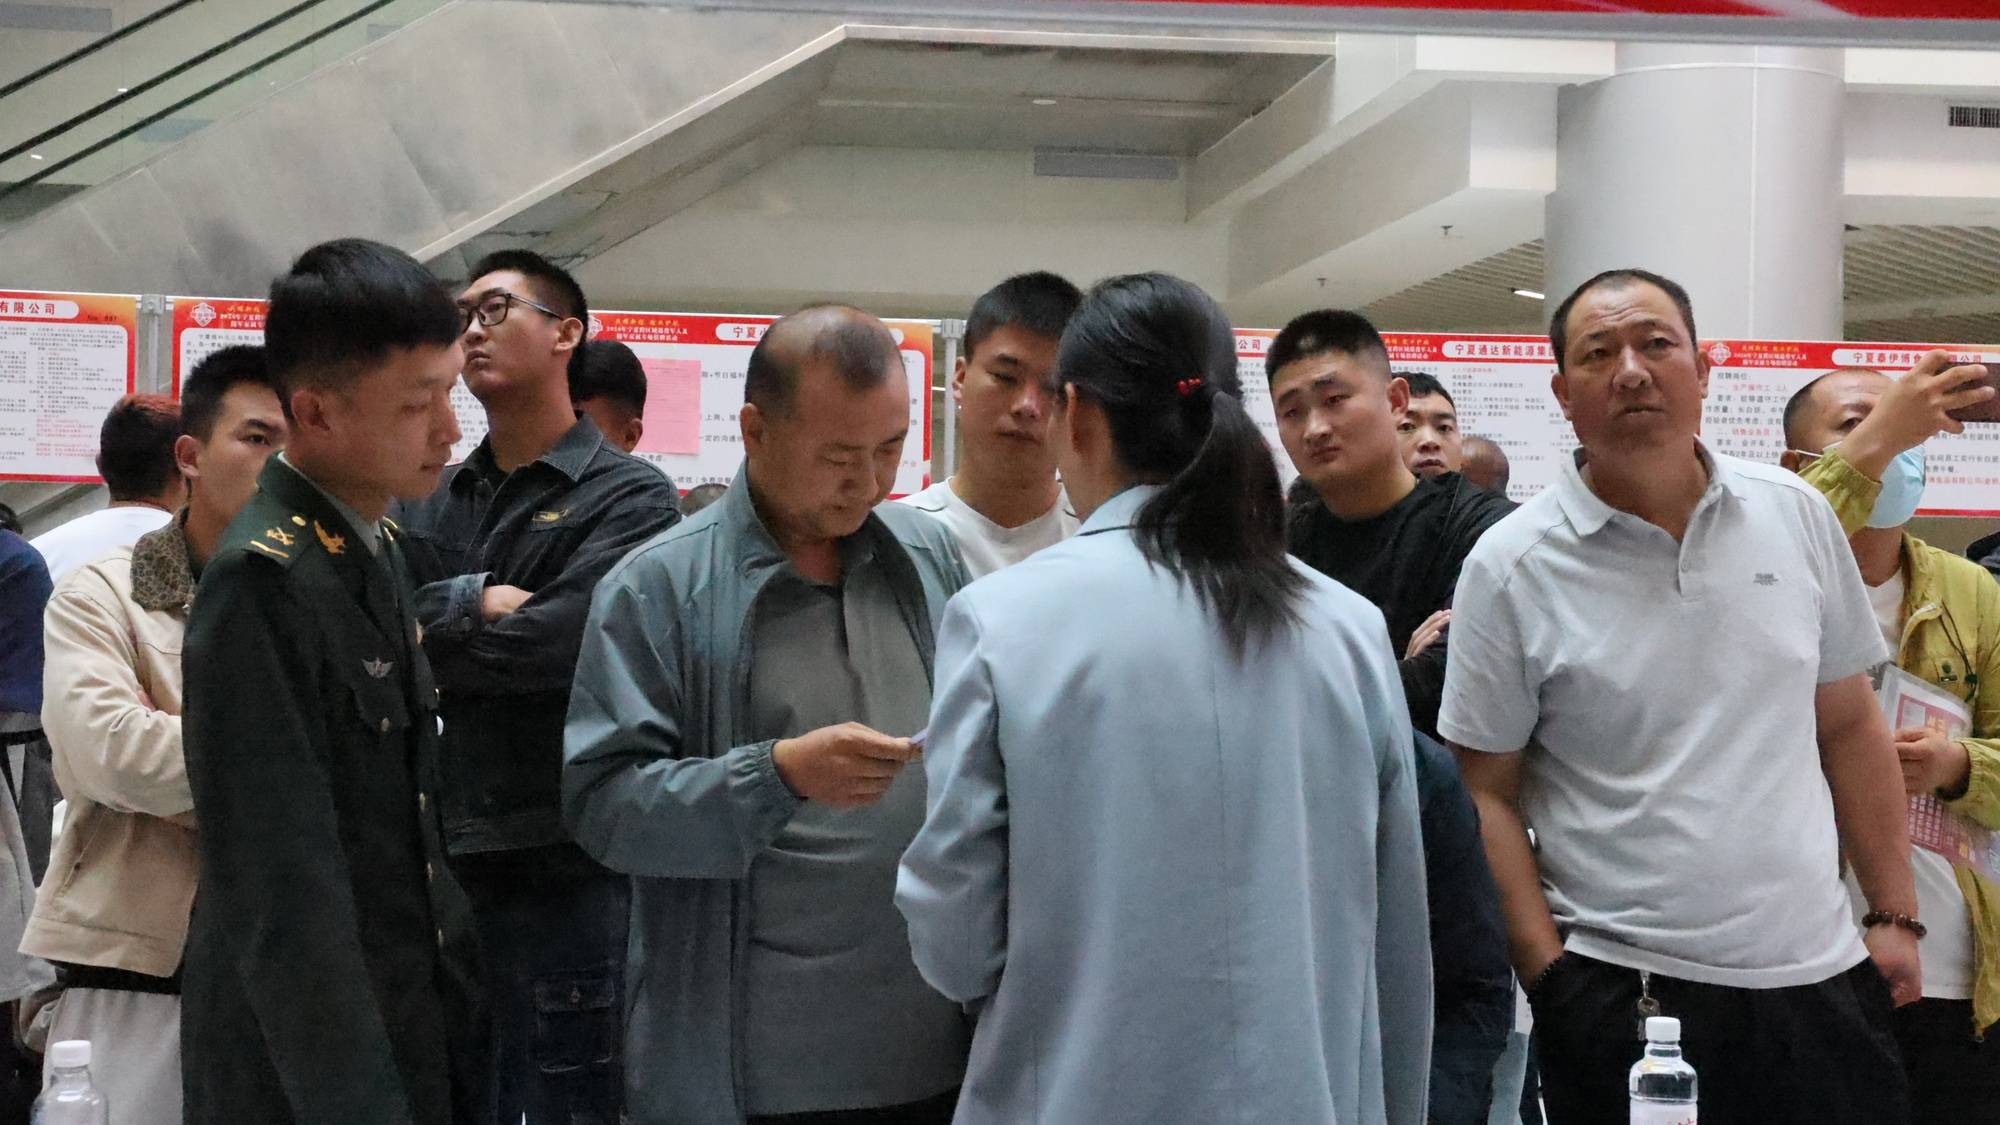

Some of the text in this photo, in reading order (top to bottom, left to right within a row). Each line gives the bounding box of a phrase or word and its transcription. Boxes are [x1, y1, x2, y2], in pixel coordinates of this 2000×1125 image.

[0, 301, 56, 315] 有限公司
[1238, 339, 1261, 350] 公司
